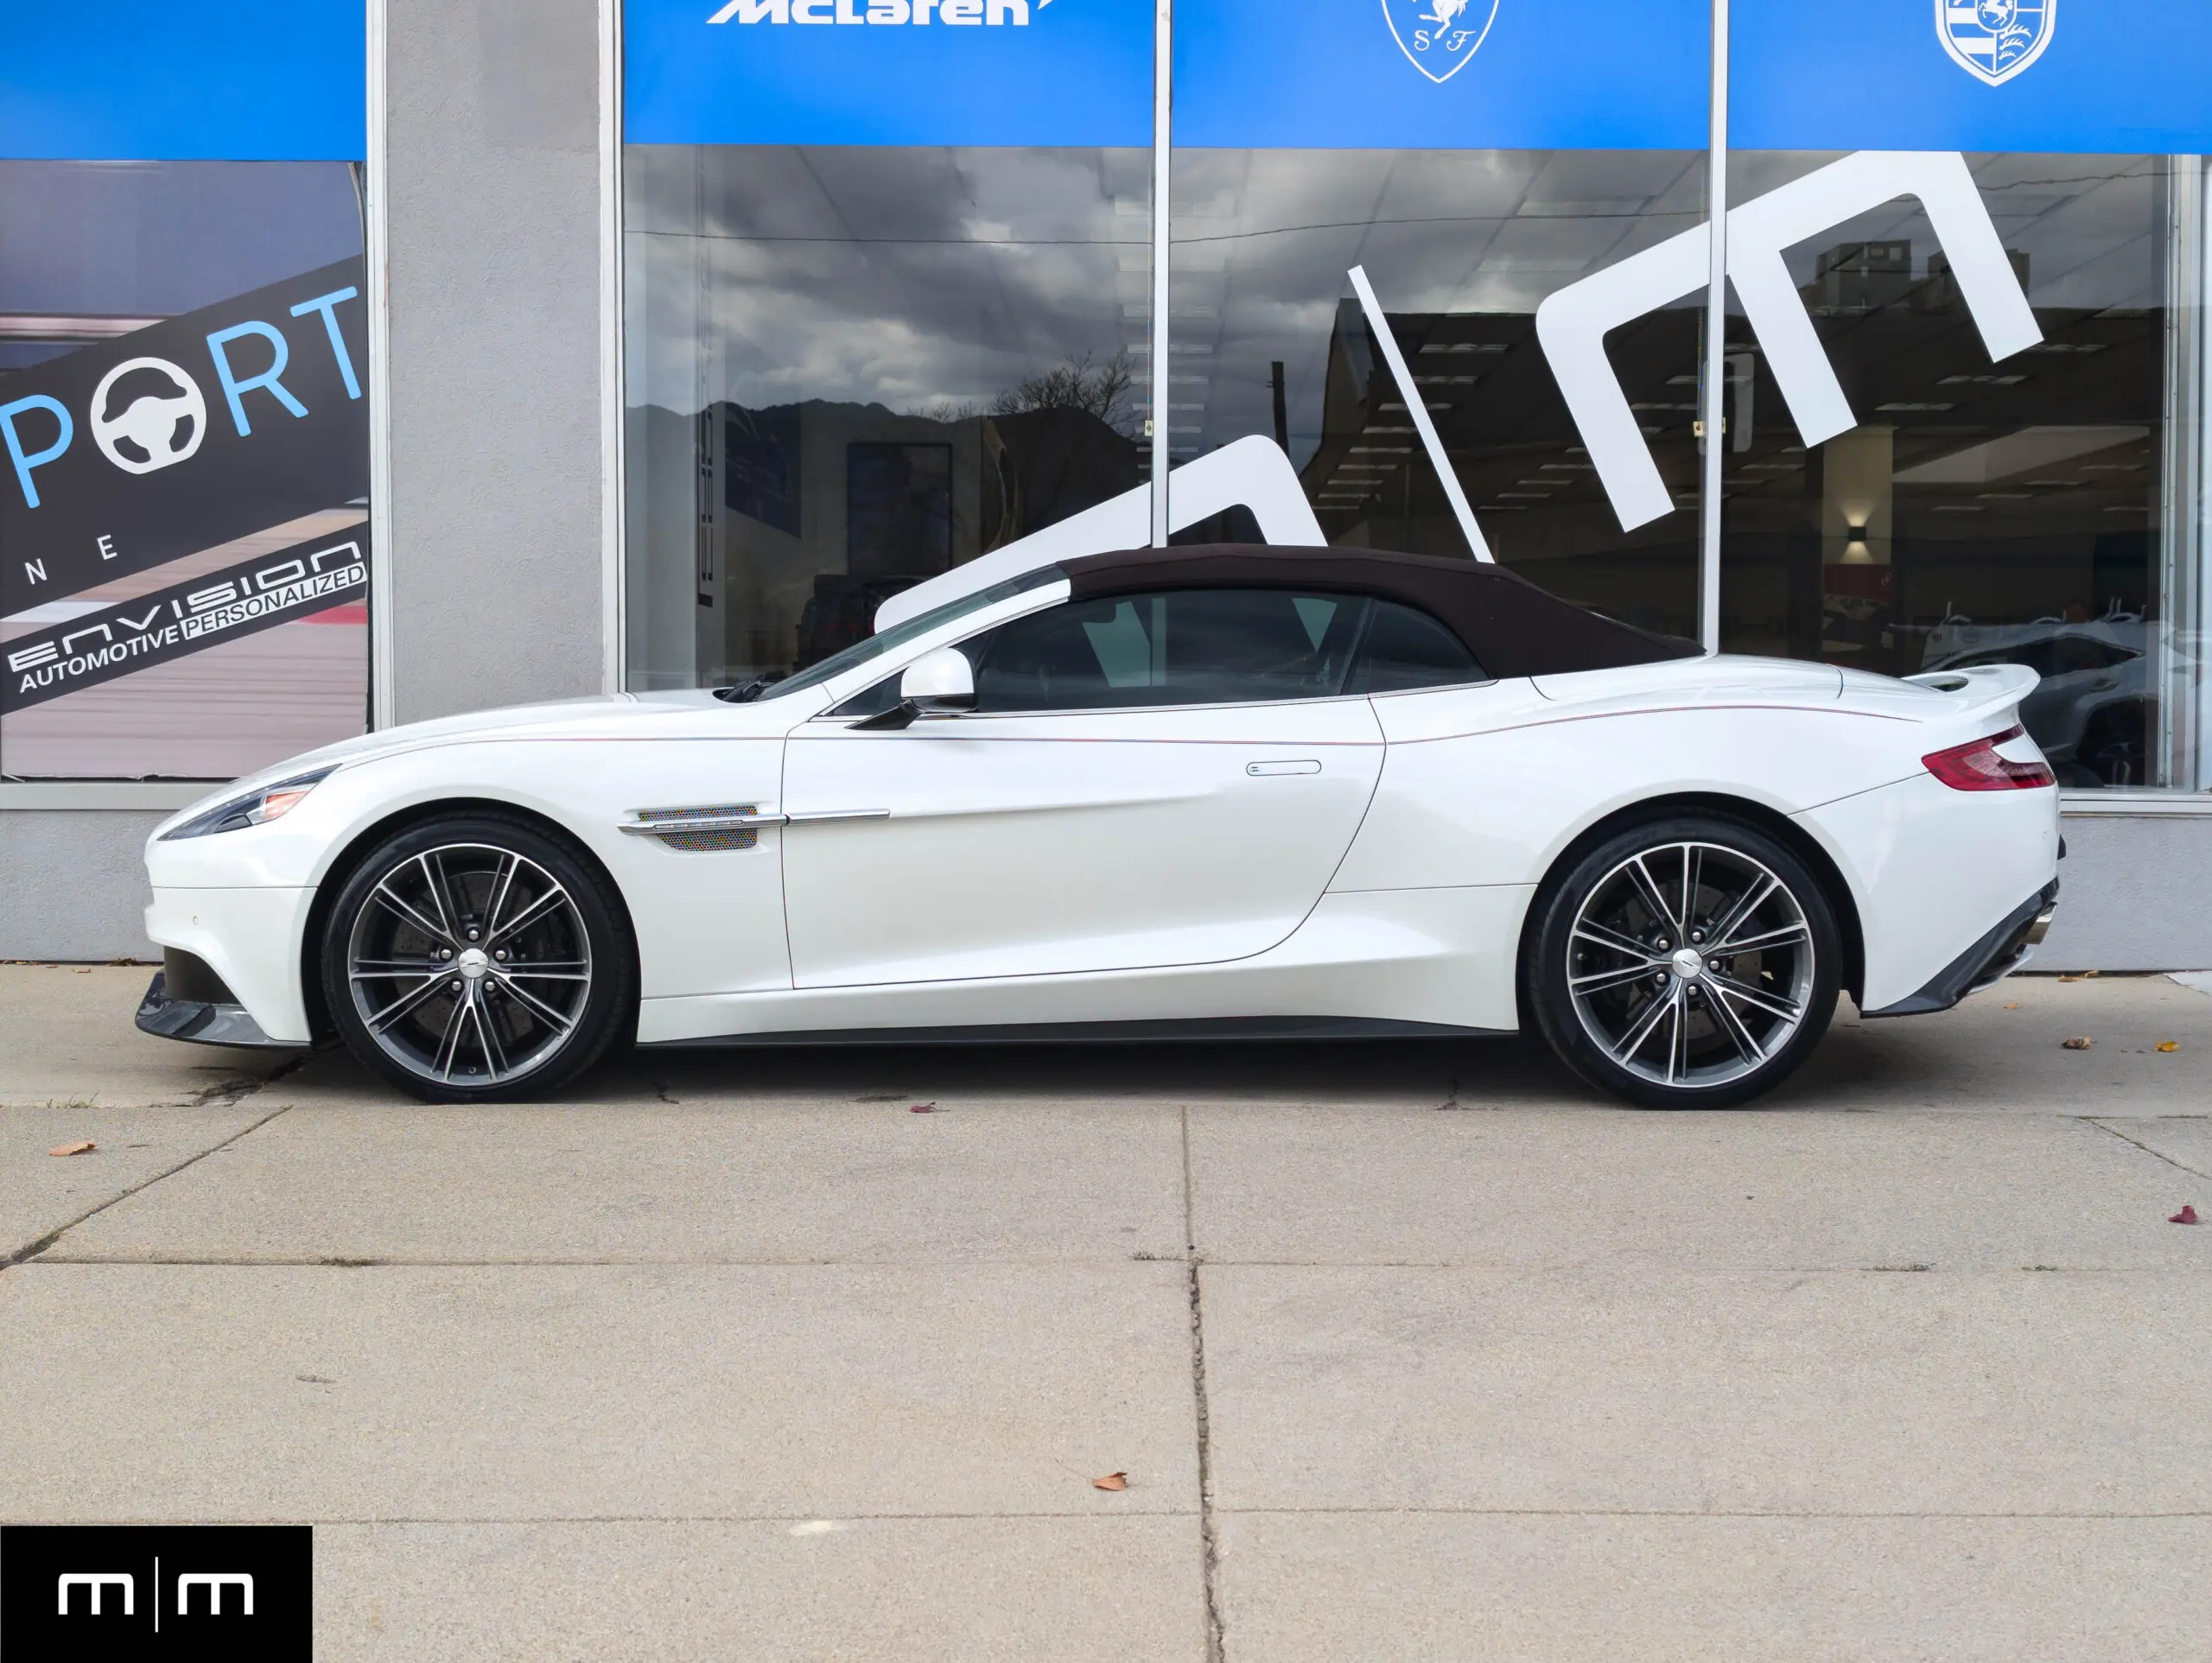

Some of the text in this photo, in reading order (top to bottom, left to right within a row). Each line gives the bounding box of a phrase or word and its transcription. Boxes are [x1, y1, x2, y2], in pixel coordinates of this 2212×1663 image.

[705, 0, 1030, 26] McLaren
[19, 563, 365, 694] AUTOMOTIVE PERSONALIZED
